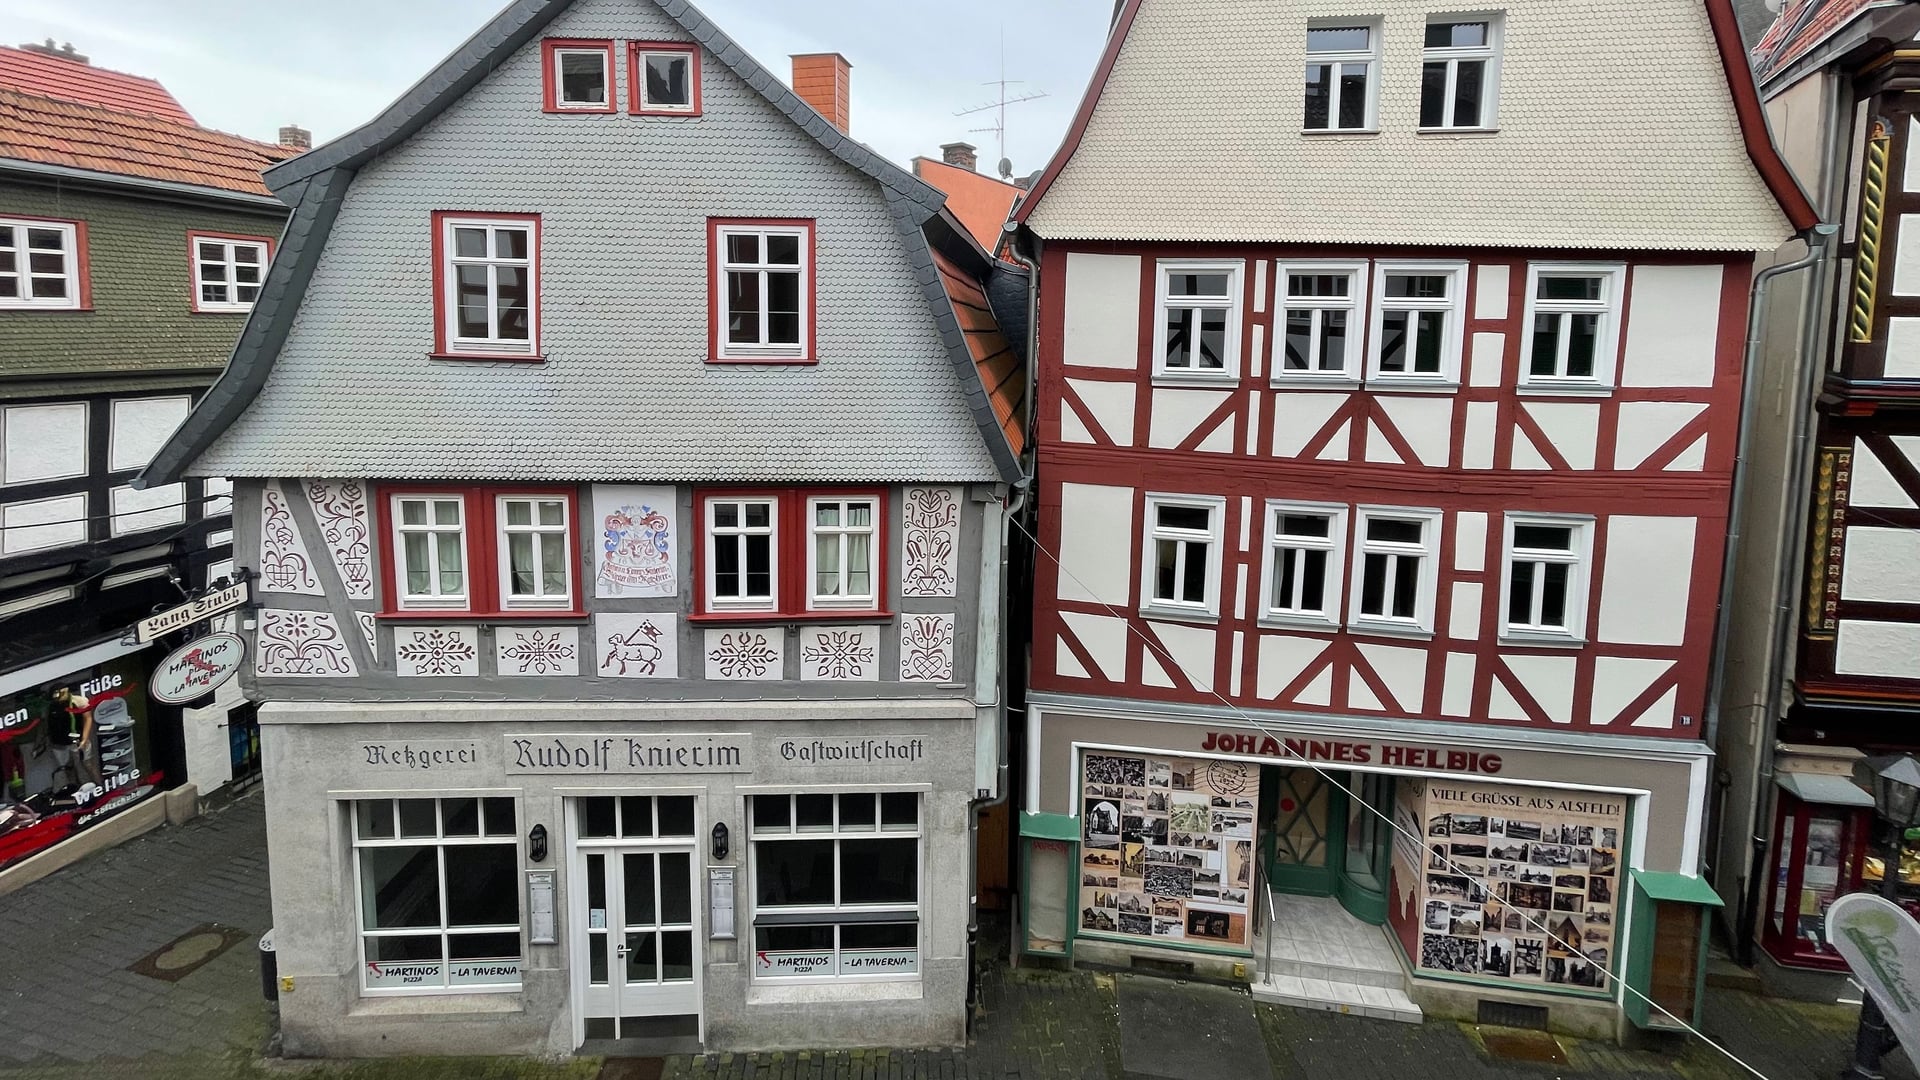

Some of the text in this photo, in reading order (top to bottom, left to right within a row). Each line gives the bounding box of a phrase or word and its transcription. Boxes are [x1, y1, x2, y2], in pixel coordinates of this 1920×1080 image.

[147, 609, 191, 631] Lang
[169, 641, 228, 675] MARTINOS
[79, 674, 122, 696] Füße
[363, 744, 477, 769] Metzgerei
[512, 738, 741, 771] Rudolf Knierim
[1201, 732, 1503, 774] JOHANNES HELBIG
[1431, 788, 1468, 802] VIELE
[1471, 790, 1523, 807] GRÜSSE
[1527, 797, 1554, 810] AUS
[1558, 800, 1620, 816] ALSFELD!
[385, 965, 440, 977] MARTINOS
[472, 966, 517, 976] TAVERNA
[777, 956, 829, 967] MARTINOS
[864, 957, 907, 966] TAVERNA
